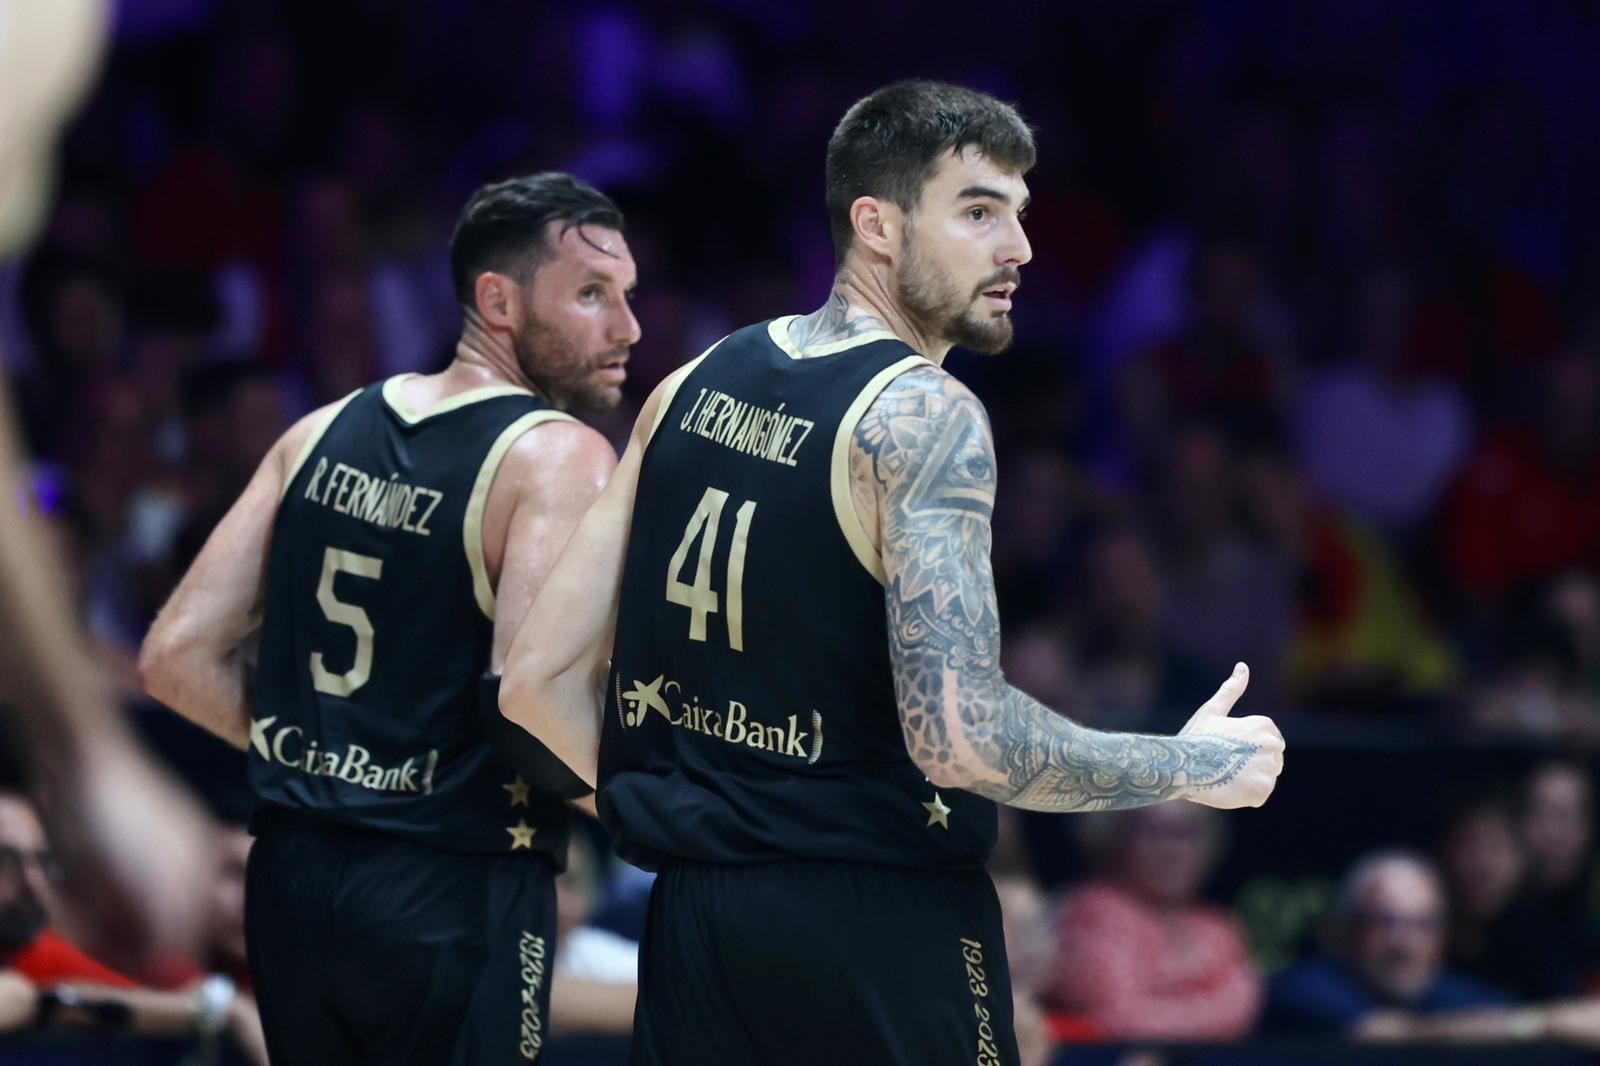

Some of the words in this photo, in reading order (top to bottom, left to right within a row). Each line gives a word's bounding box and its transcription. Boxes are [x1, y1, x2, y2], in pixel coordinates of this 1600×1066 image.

[680, 387, 815, 467] J.HERNANGÓMEZ
[309, 546, 384, 699] 5
[665, 486, 758, 653] 41
